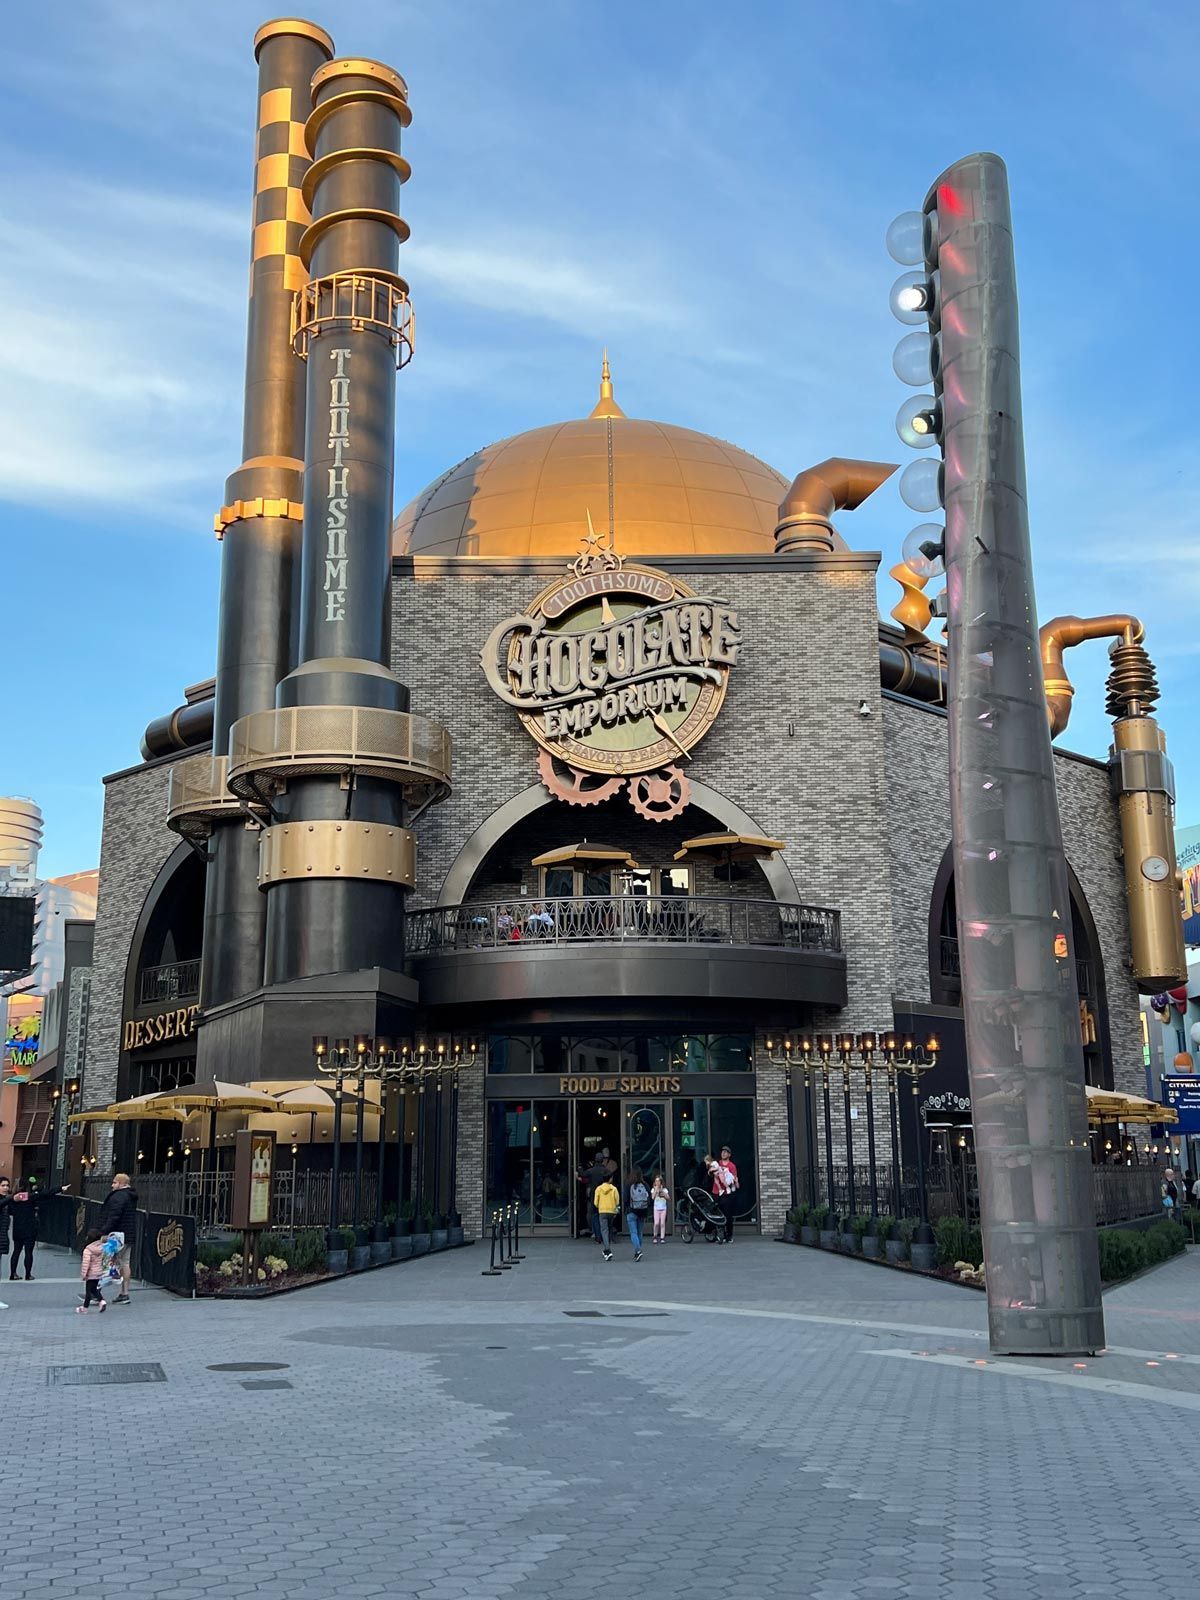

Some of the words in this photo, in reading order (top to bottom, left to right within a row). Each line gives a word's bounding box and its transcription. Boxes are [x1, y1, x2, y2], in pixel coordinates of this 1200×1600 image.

[323, 348, 351, 621] TOOTHSOME
[550, 573, 667, 608] TOOTHSOME
[479, 602, 744, 708] CHOCOLATE
[543, 676, 688, 739] EMPORIUM
[571, 743, 624, 763] SAVORY
[123, 1004, 201, 1051] DESSERT
[559, 1076, 600, 1094] FOOD
[620, 1076, 681, 1095] SPIRITS
